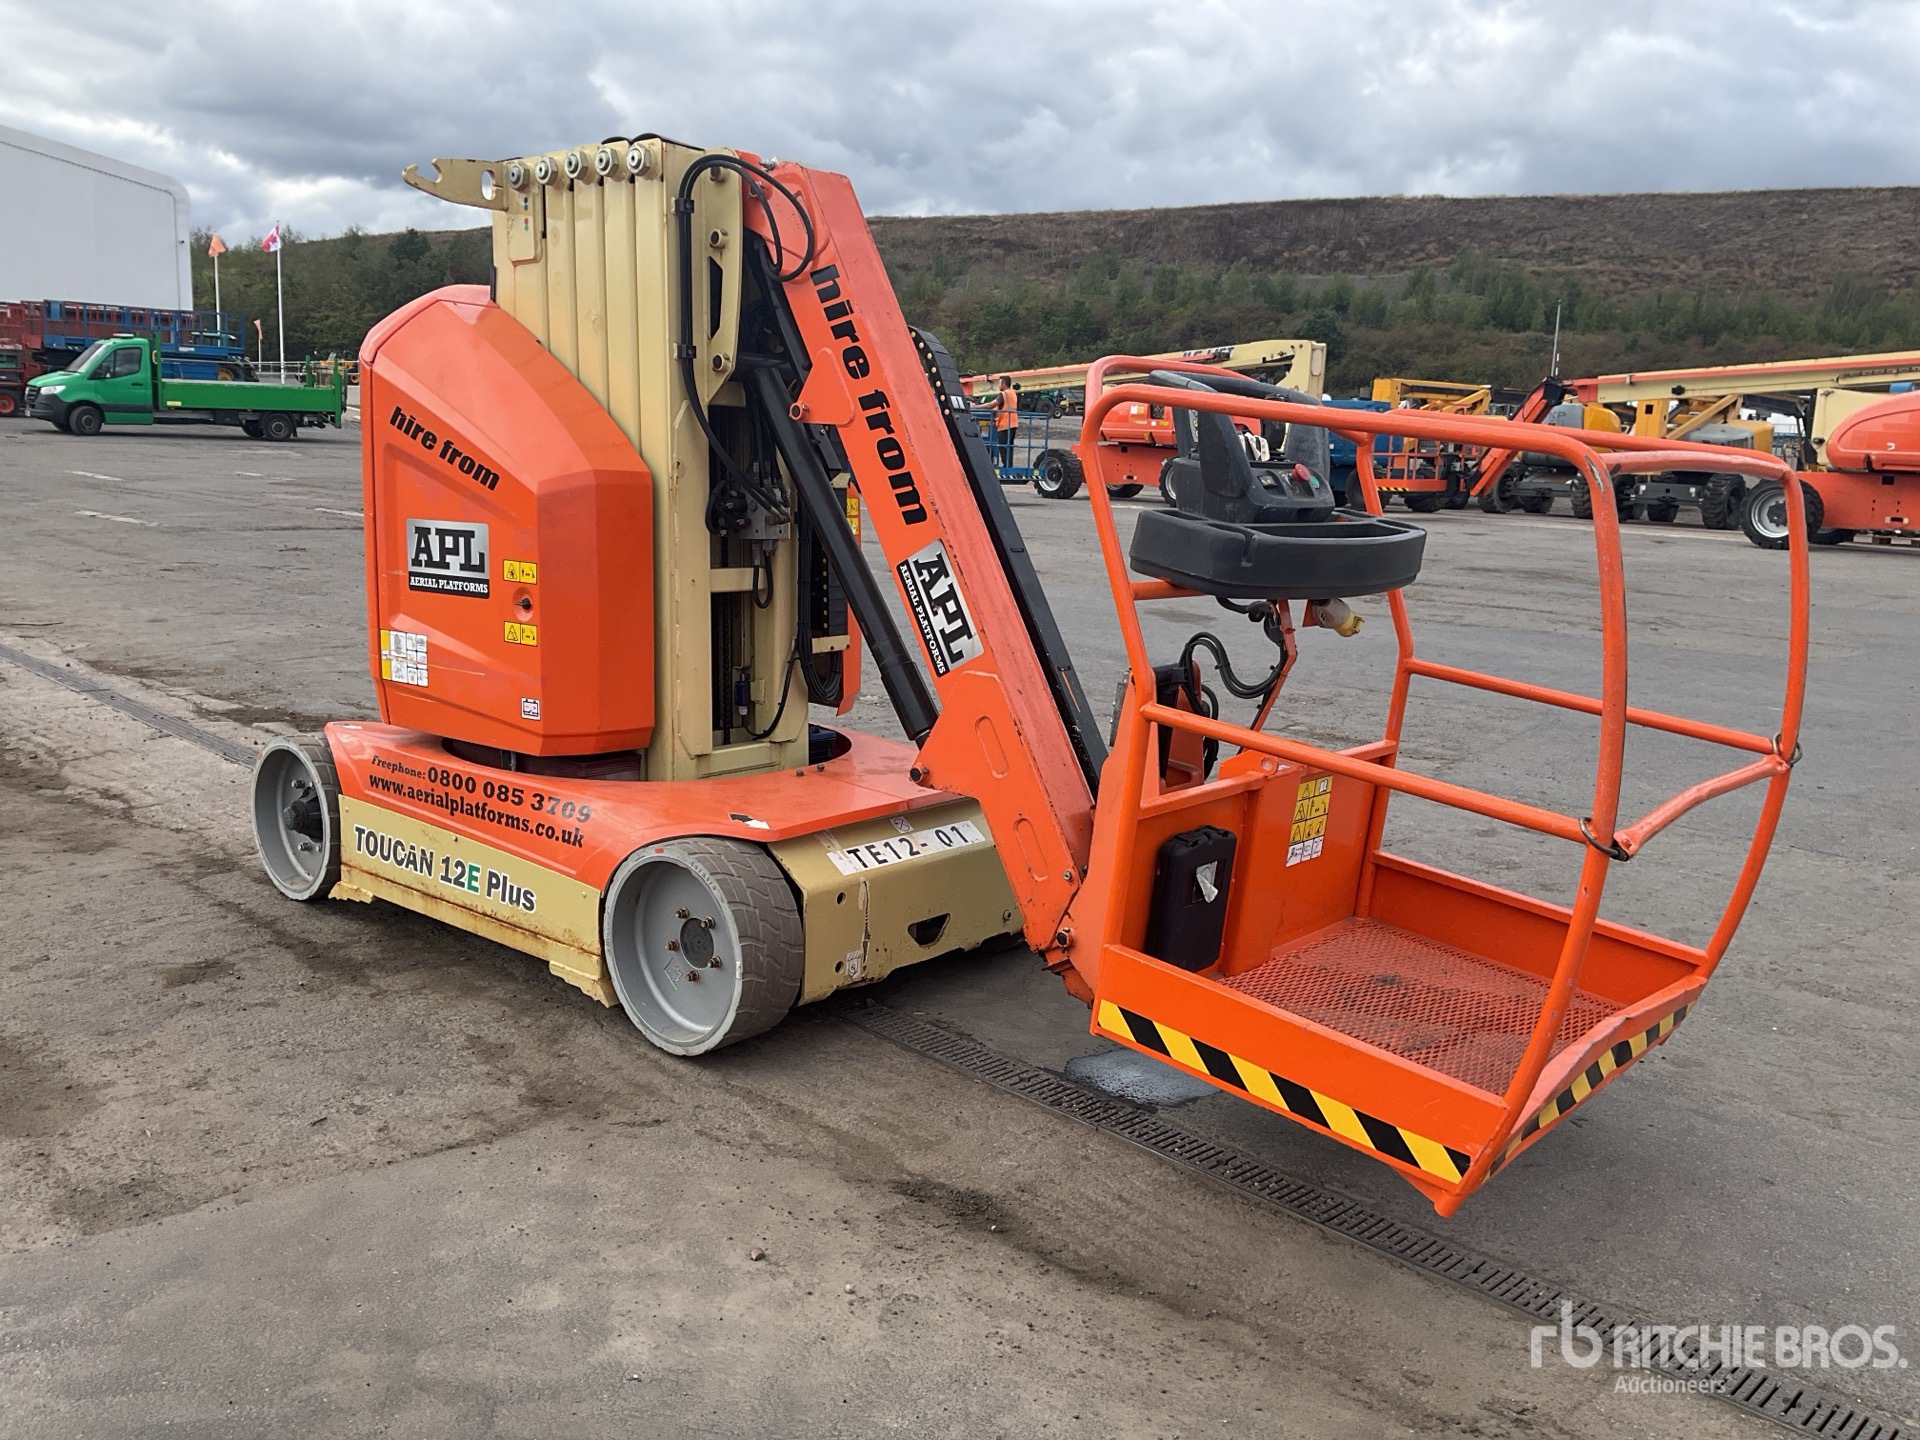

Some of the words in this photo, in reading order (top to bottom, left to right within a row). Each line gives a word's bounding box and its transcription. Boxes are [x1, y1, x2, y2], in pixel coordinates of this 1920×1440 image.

[810, 264, 870, 379] hire
[858, 389, 928, 525] from
[389, 405, 437, 451] hire
[438, 440, 500, 491] from
[409, 576, 438, 589] AERIAL
[438, 580, 489, 594] PLATFORMS
[410, 526, 486, 574] APL
[899, 564, 918, 606] AERIAL
[916, 604, 946, 674] PLATFORMS
[912, 552, 973, 665] APL
[369, 774, 585, 848] www.aerialplatforms.co.uk
[371, 755, 426, 780] Freephone:
[427, 766, 477, 794] 0800
[482, 781, 524, 807] 085
[530, 792, 592, 823] 3709
[354, 825, 435, 878] TOUCAN
[440, 856, 481, 893] 12E
[486, 869, 536, 912] Plus
[934, 825, 969, 848] 01
